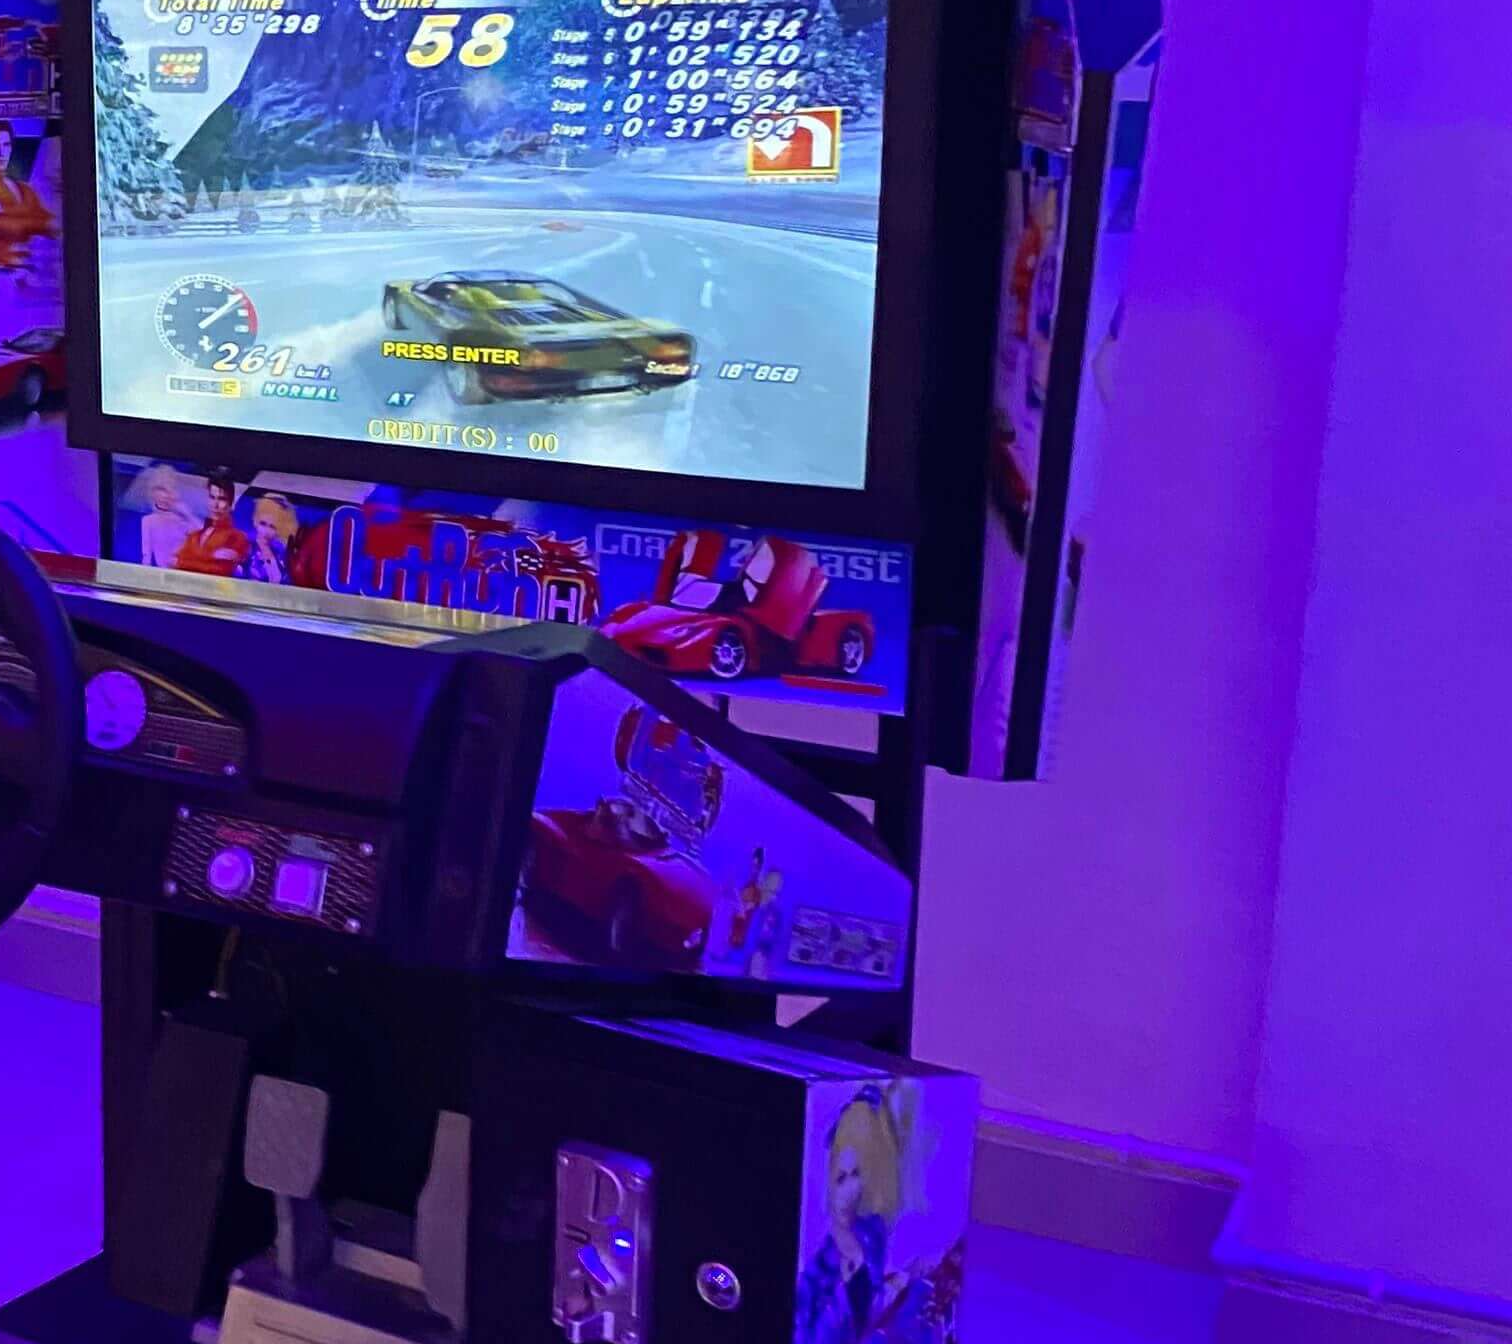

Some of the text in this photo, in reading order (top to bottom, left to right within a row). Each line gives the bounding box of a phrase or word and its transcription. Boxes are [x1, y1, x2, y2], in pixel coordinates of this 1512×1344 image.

[405, 13, 514, 68] 58
[551, 30, 589, 43] Stage
[551, 53, 588, 67] Stage
[551, 77, 588, 90] Stage
[550, 100, 587, 113] Stage
[550, 123, 586, 137] Stage
[212, 341, 293, 376] 261
[382, 342, 521, 365] PRESS ENTER
[262, 382, 340, 402] NORMAL
[386, 392, 415, 406] AT
[326, 506, 541, 620] OutRun
